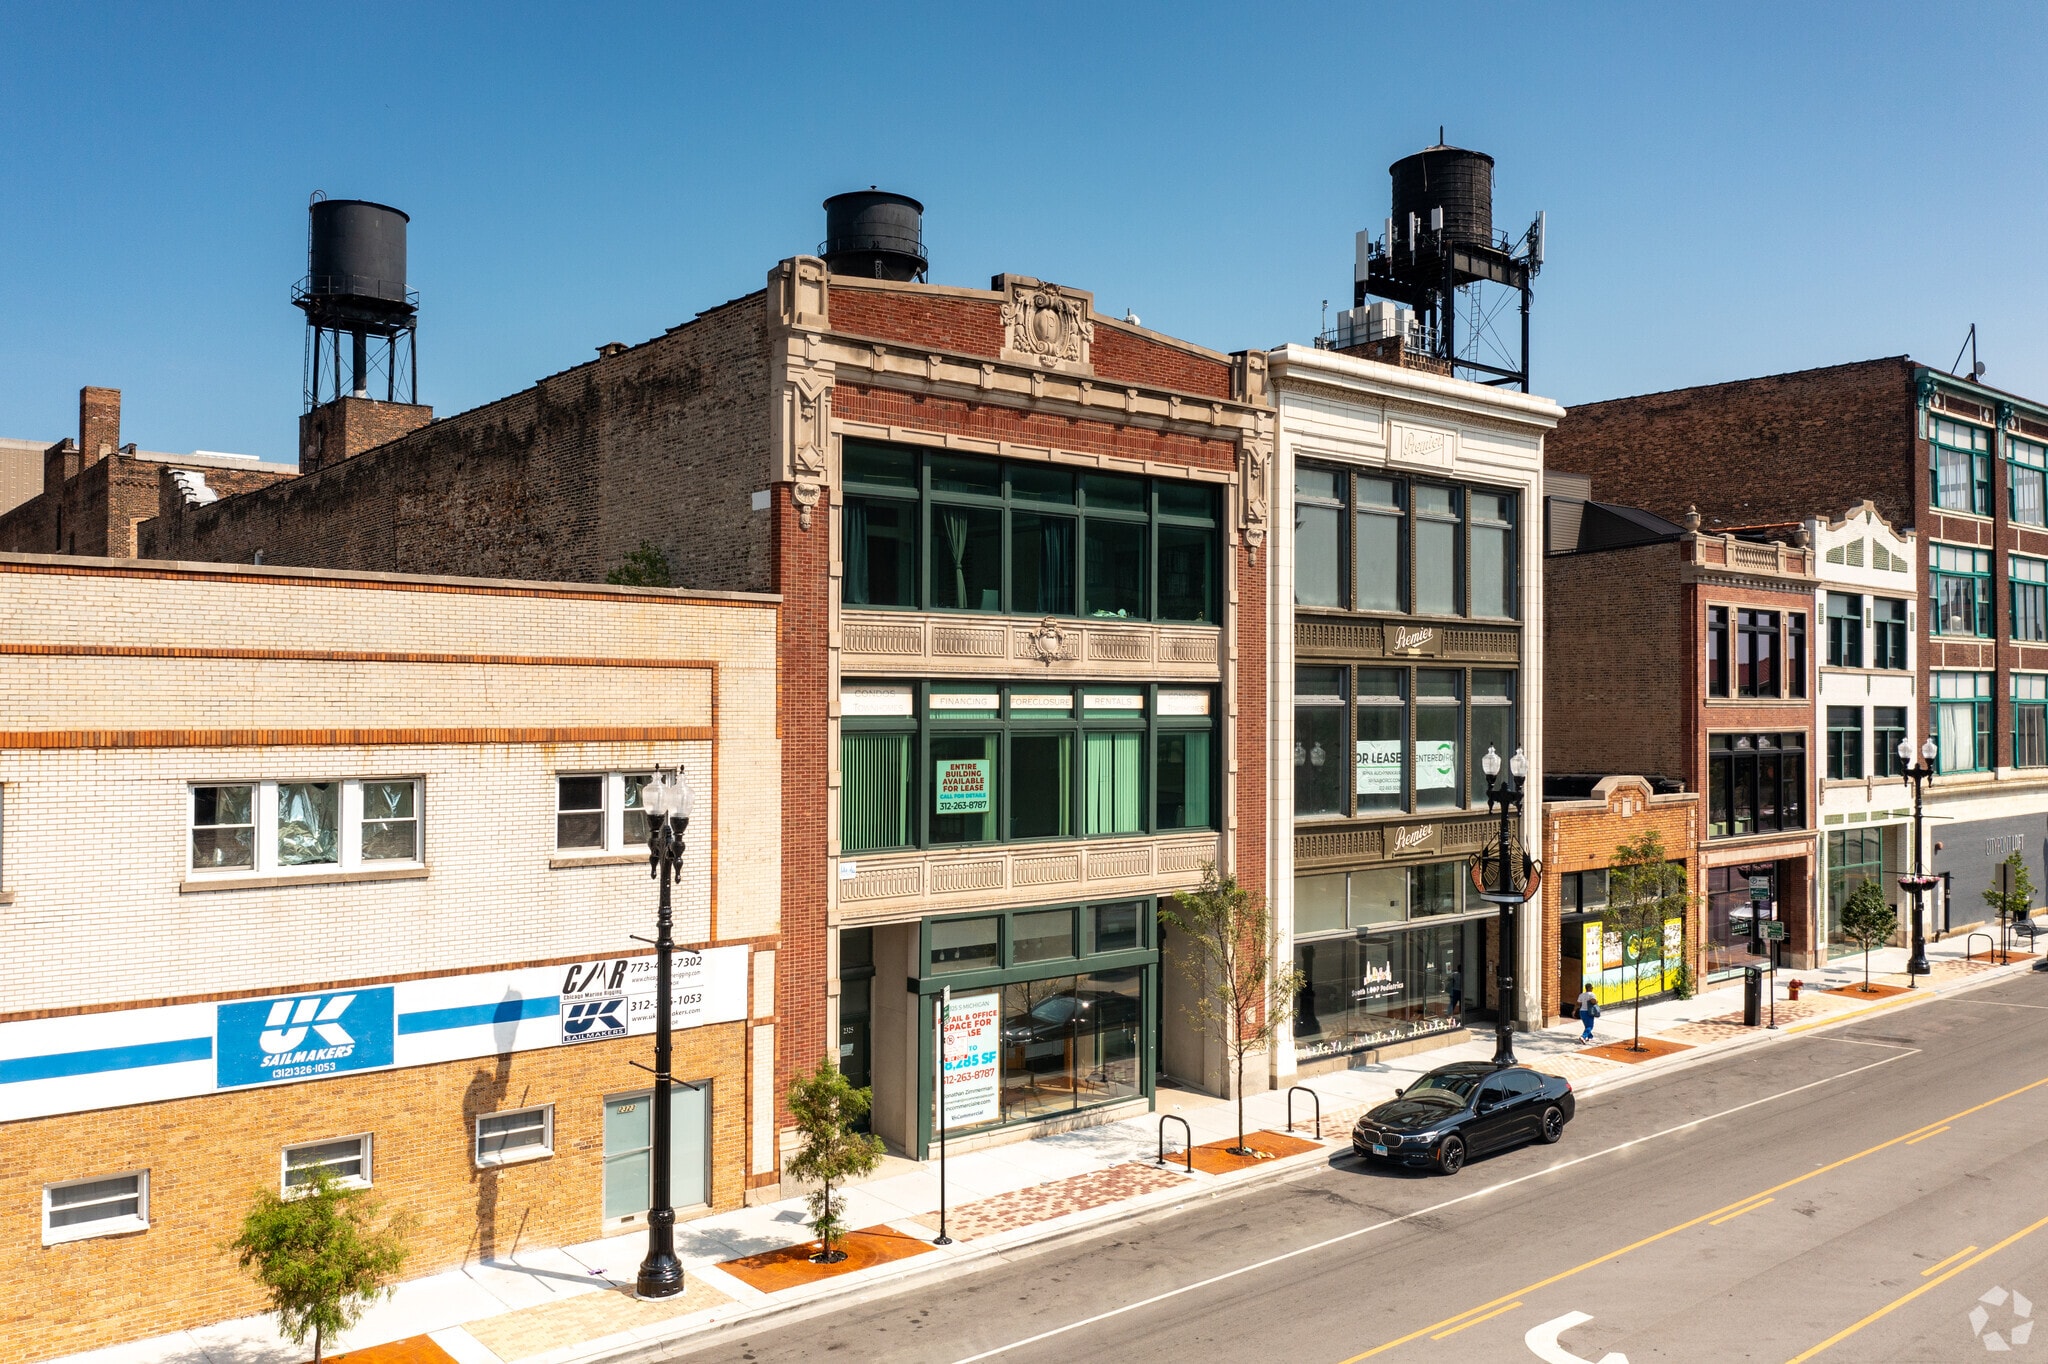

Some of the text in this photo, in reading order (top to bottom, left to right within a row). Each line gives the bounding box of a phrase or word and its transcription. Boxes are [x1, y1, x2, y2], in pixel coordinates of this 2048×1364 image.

[1394, 625, 1433, 650] Premier
[854, 689, 896, 698] CONDOS
[940, 697, 988, 706] FINANCING
[1010, 697, 1071, 707] FORECLOSURE
[1094, 697, 1132, 706] RENTALS
[1371, 752, 1402, 764] LEASE
[945, 770, 982, 778] BUILDING
[942, 777, 985, 785] AVAILABLE
[960, 784, 984, 792] LEASE
[939, 800, 988, 811] 312-263-8787
[1394, 824, 1434, 851] Premier
[563, 988, 623, 1001] Chicago Marine Rigging
[963, 1001, 991, 1009] MICHIGAN
[564, 999, 625, 1034] UK
[972, 1009, 998, 1020] OFFICE
[259, 994, 358, 1054] UK
[944, 1018, 992, 1032] SPACE FOR
[566, 1028, 625, 1041] SAILMAKERS
[260, 1044, 355, 1067] SAILMAKERS
[981, 1050, 997, 1065] SF
[272, 1062, 337, 1078] (312)326-1053
